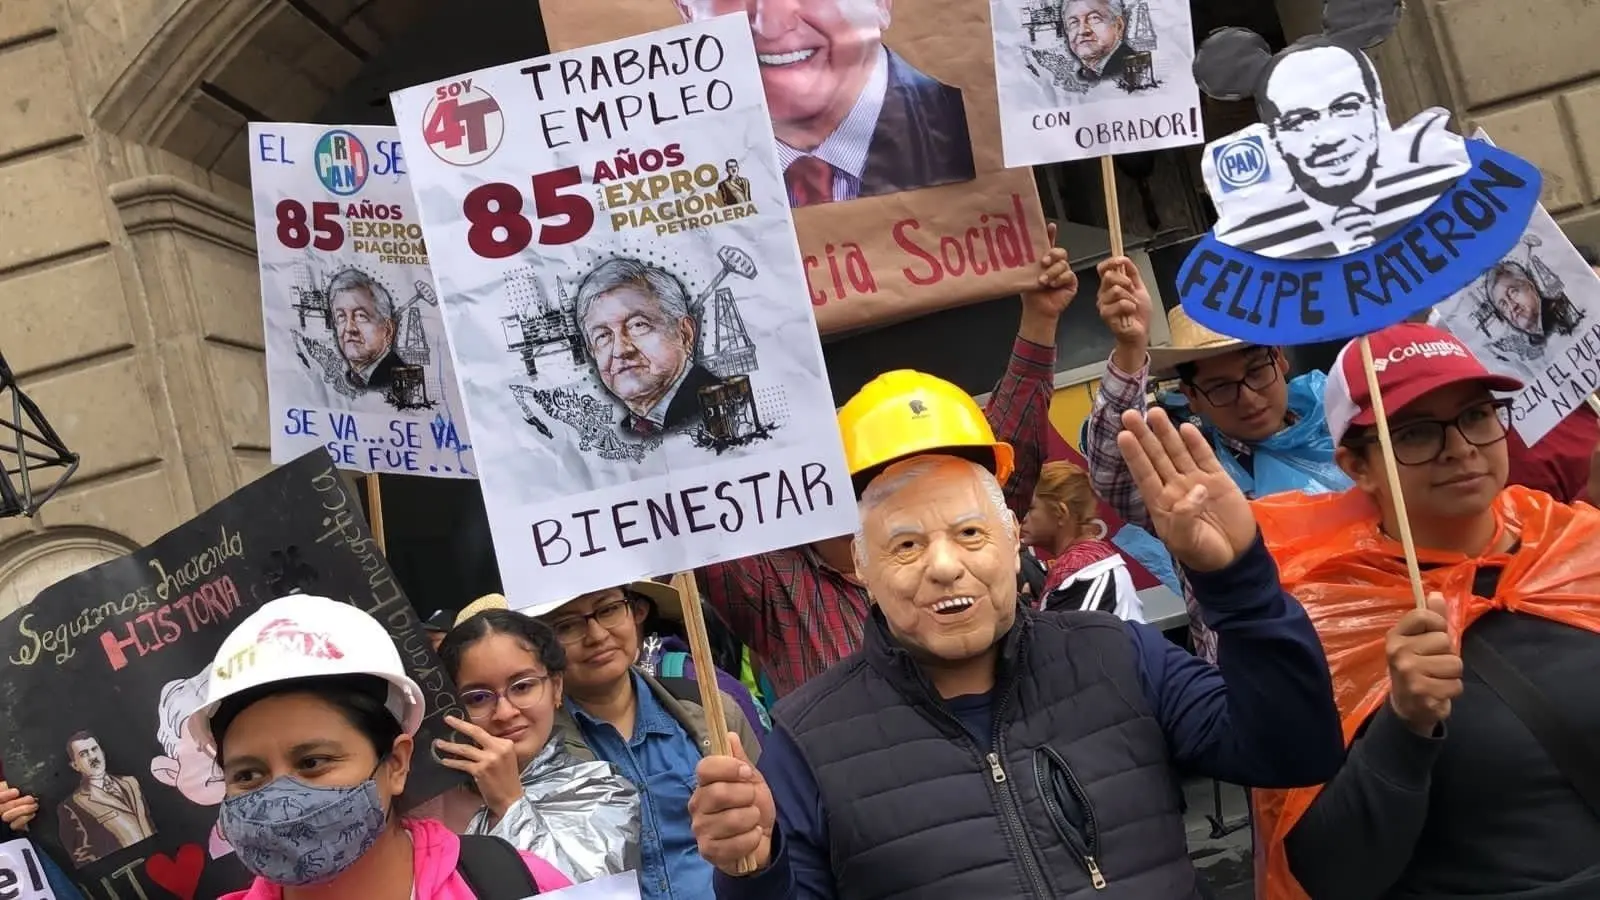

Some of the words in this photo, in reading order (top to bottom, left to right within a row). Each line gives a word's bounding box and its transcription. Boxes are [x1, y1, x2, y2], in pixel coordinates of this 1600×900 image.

[436, 78, 472, 100] SOY
[520, 34, 724, 101] TRABAJO
[427, 98, 500, 154] 4T
[540, 79, 733, 149] EMPLEO
[1032, 110, 1071, 131] CON
[1074, 106, 1198, 148] OBRADOR!
[259, 133, 295, 164] EL
[373, 140, 406, 175] SE
[593, 143, 685, 184] AÑOS
[1224, 148, 1259, 178] PAN
[604, 163, 719, 209] EXPRO
[276, 199, 345, 251] 85
[346, 199, 403, 220] AÑOS
[352, 221, 423, 240] EXPRO
[463, 165, 595, 259] 85
[656, 203, 758, 236] PETROLERA
[380, 255, 430, 265] PETROLE
[893, 192, 1036, 286] Social
[1181, 248, 1326, 328] FELIPE
[1342, 158, 1527, 317] RATERON
[1511, 379, 1548, 421] SIN
[1545, 363, 1571, 387] EL
[1551, 359, 1600, 418] NAD
[284, 408, 319, 437] SE
[389, 419, 422, 449] SE
[327, 441, 357, 465] SE
[531, 462, 833, 567] BIENESTAR
[9, 586, 157, 665] Seguimos
[100, 575, 242, 671] HISTORIA
